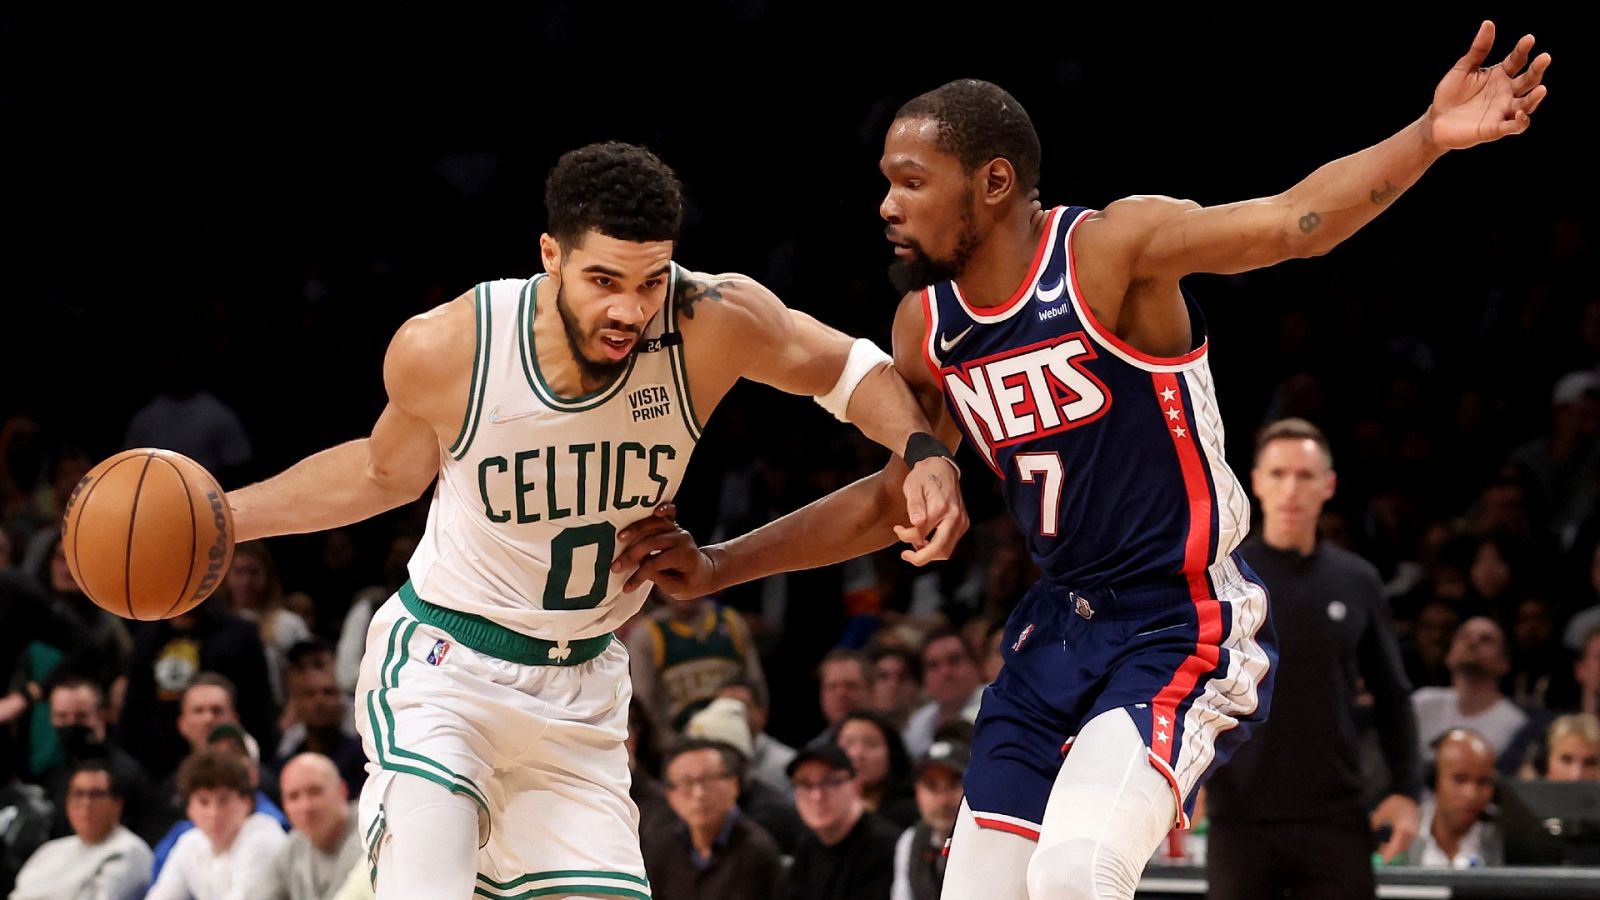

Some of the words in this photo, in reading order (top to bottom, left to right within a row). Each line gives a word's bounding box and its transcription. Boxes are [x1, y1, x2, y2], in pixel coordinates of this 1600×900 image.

[1038, 302, 1068, 321] Webull
[648, 341, 662, 352] 24
[628, 386, 670, 410] VISTA
[632, 402, 671, 423] PRINT
[943, 336, 1107, 472] NETS
[478, 441, 677, 525] CELTICS
[1013, 452, 1065, 537] 7
[542, 520, 617, 611] 0
